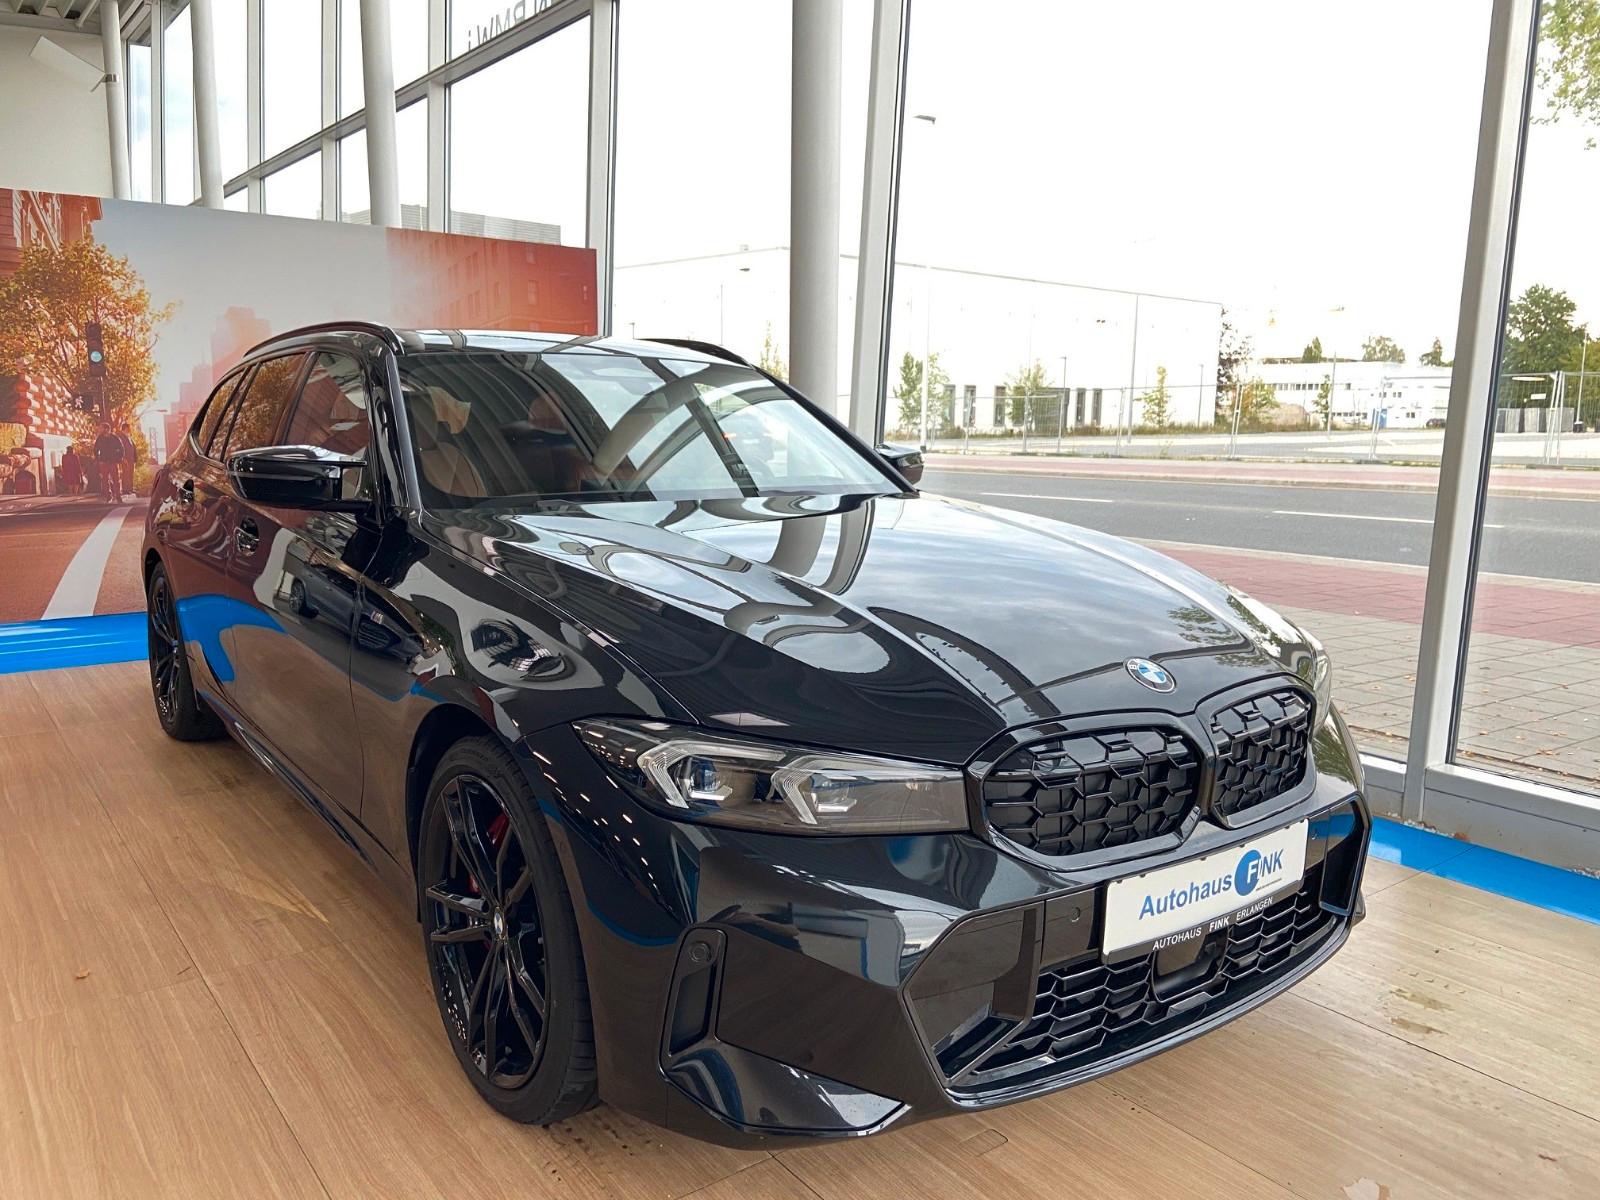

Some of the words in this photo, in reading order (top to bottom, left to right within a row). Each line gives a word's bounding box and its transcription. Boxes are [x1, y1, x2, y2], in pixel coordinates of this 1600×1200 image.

[1139, 874, 1232, 920] Autohaus
[1246, 848, 1284, 884] FINK
[1152, 927, 1202, 951] AUTOHAUS
[1209, 915, 1230, 932] FINK
[1236, 896, 1273, 921] ERLANGEN
